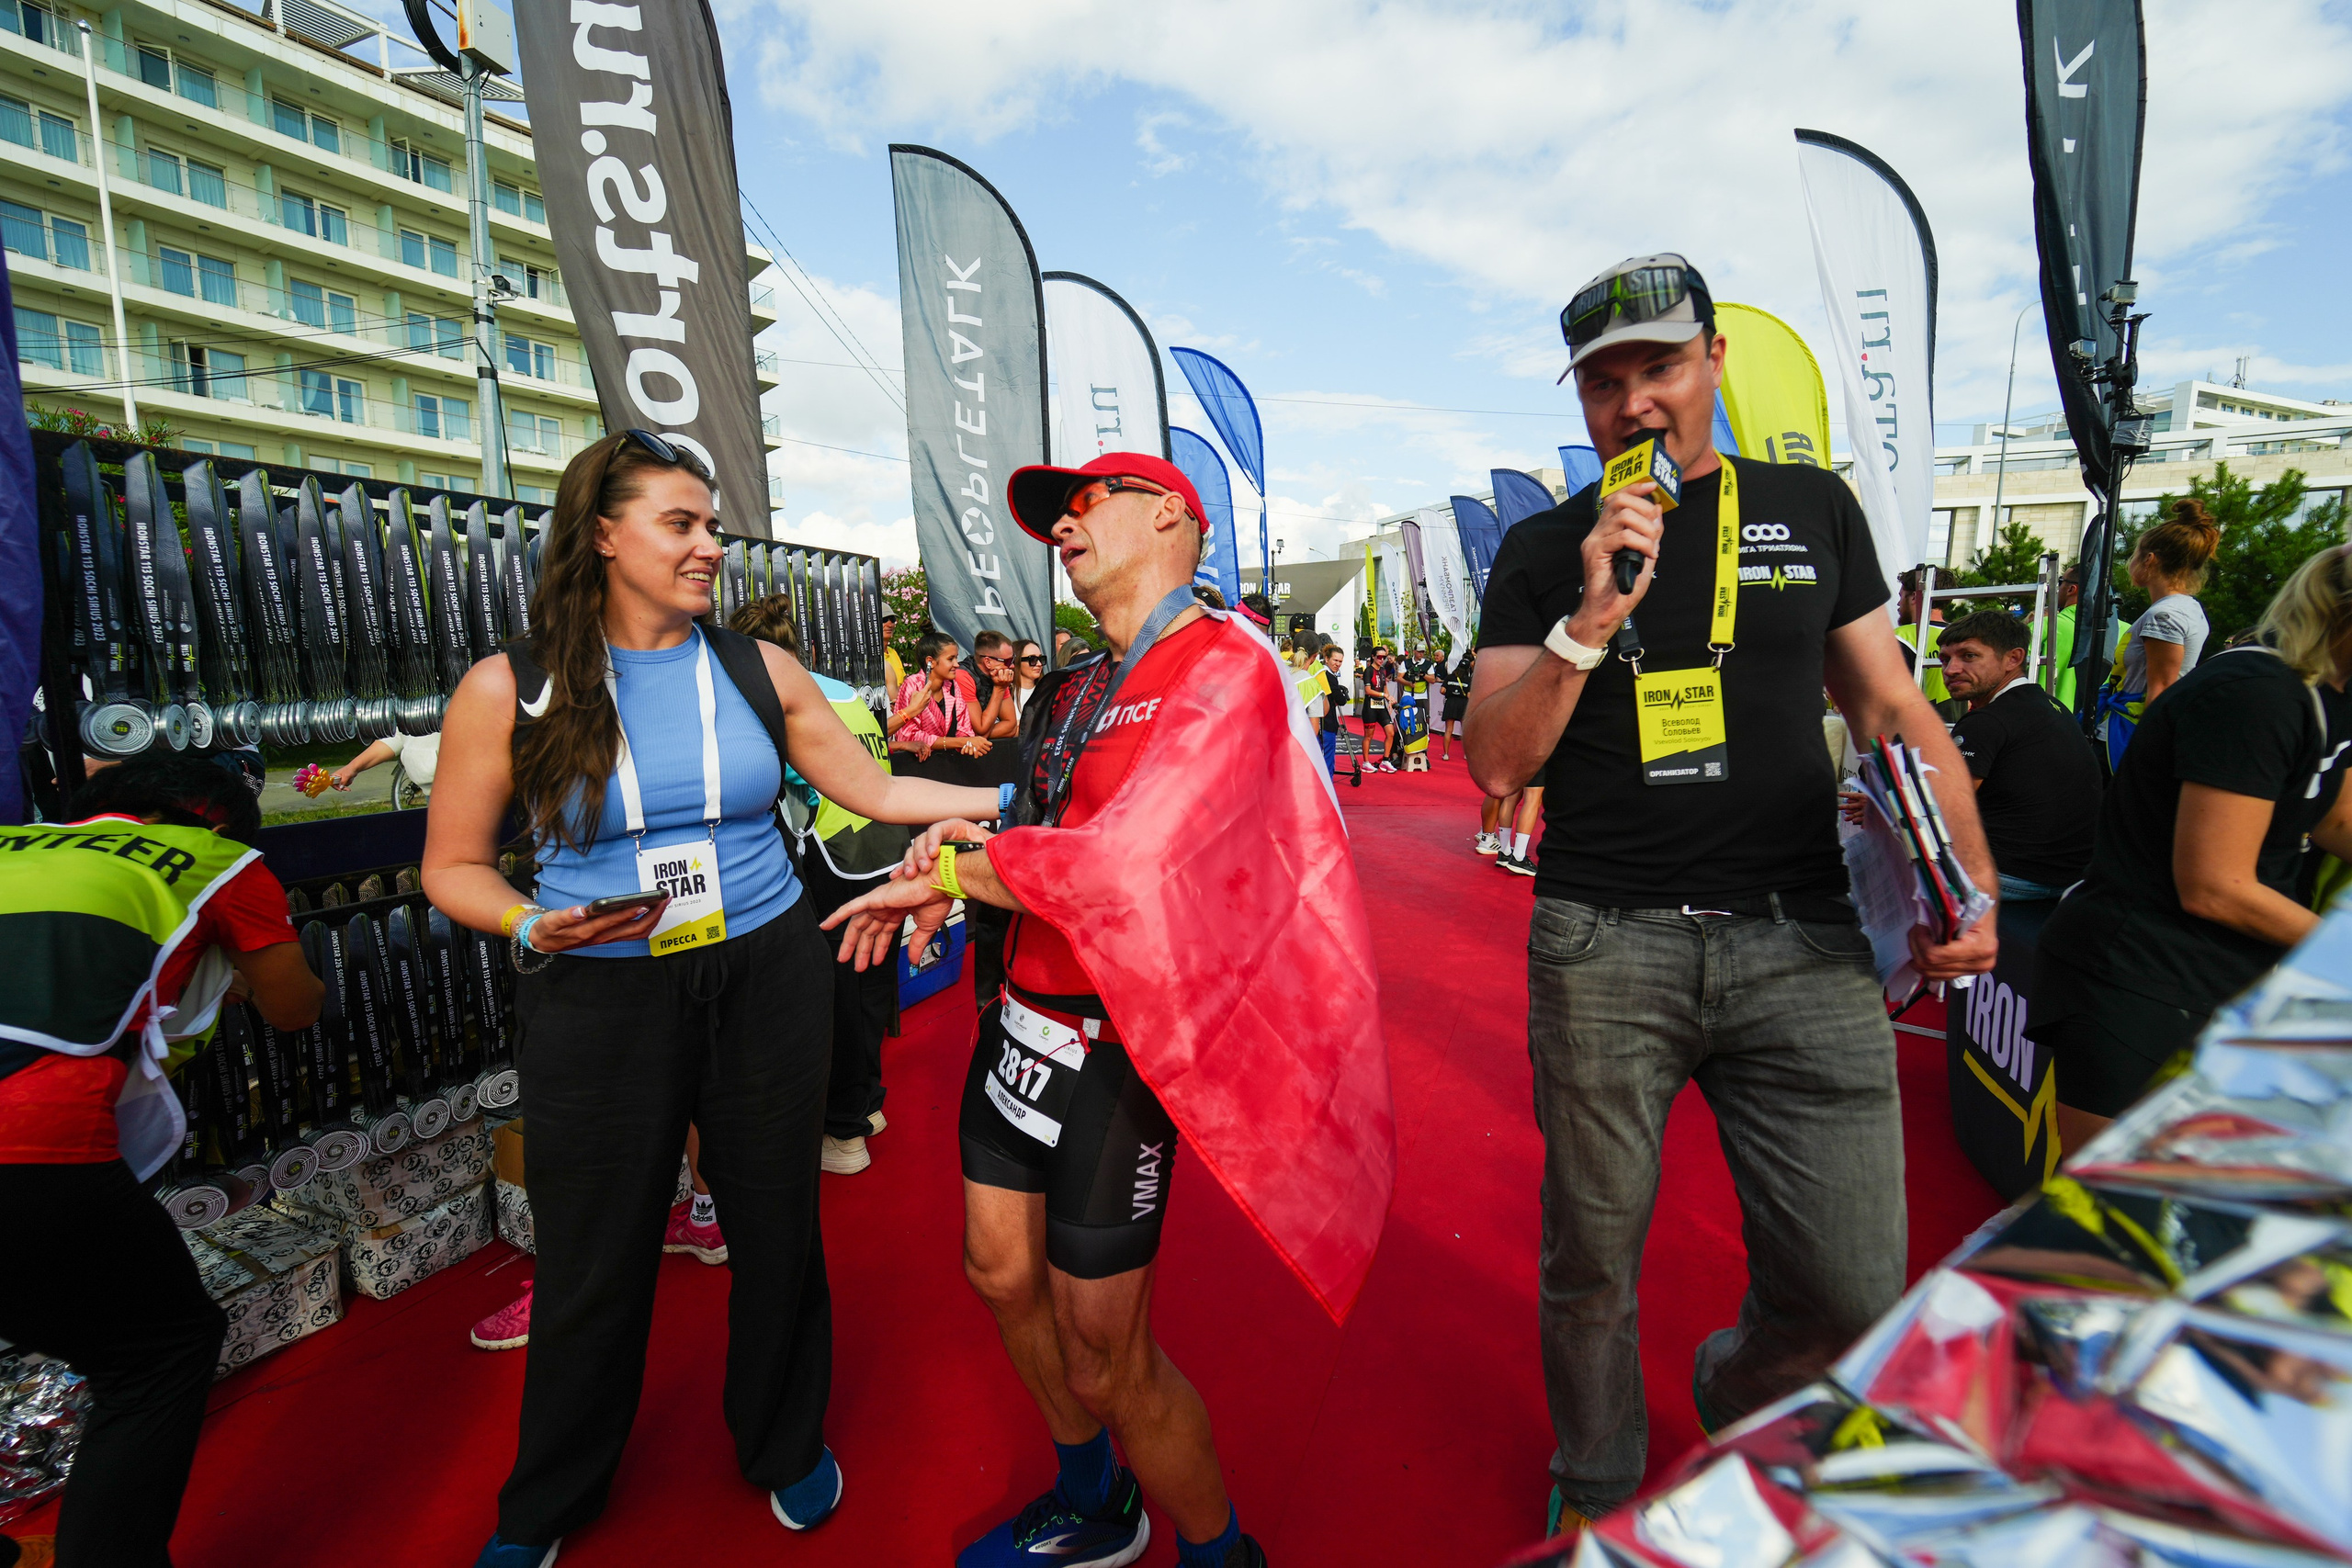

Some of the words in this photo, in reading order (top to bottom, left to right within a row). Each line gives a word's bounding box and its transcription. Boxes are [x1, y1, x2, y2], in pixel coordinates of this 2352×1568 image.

[1574, 283, 1608, 315] IRON
[1611, 456, 1634, 475] IRON
[1656, 451, 1672, 472] IRON
[1609, 461, 1643, 488] STAR
[1654, 462, 1678, 494] STAR
[76, 515, 92, 554] IRONSTAR
[136, 523, 151, 559] IRONSTAR
[203, 527, 221, 563] IRONSTAR
[257, 533, 275, 567] IRONSTAR
[311, 536, 324, 570] IRONSTAR
[1738, 545, 1757, 554] ИГА
[83, 557, 94, 569] 113
[354, 540, 368, 572] IRONSTAR
[401, 545, 414, 575] IRONSTAR
[141, 562, 152, 573] 113
[214, 565, 225, 577] 113
[266, 570, 277, 580] 113
[333, 560, 343, 588] IRONSTAR
[442, 551, 454, 581] IRONSTAR
[478, 553, 488, 582] IRONSTAR
[513, 555, 523, 583] IRONSTAR
[1738, 565, 1772, 581] IRON
[1782, 565, 1816, 580] STAR
[84, 570, 98, 593] SOCHI
[318, 571, 328, 582] 113
[361, 574, 369, 584] 113
[408, 577, 416, 587] 113
[142, 575, 155, 598] SOCHI
[218, 578, 231, 600] SOCHI
[269, 581, 282, 603] SOCHI
[321, 583, 333, 604] SOCHI
[363, 585, 374, 605] SOCHI
[1239, 582, 1257, 594] RON
[1719, 586, 1727, 600] STAR
[410, 588, 421, 607] SOCHI
[450, 592, 460, 611] SOCHI
[482, 594, 491, 612] SOCHI
[518, 594, 527, 612] SOCHI
[87, 596, 102, 620] SIRIUS
[146, 600, 161, 624] SIRIUS
[224, 602, 236, 624] SIRIUS
[276, 604, 287, 625] SIRIUS
[325, 605, 336, 626] SIRIUS
[368, 606, 379, 626] SIRIUS
[414, 608, 425, 627] SIRIUS
[454, 612, 464, 631] SIRIUS
[485, 613, 493, 631] SIRIUS
[521, 613, 530, 631] SIRIUS
[92, 623, 107, 641] 2023
[152, 626, 164, 643] 2023
[230, 626, 239, 643] 2023
[282, 627, 290, 643] 2023
[331, 628, 340, 643] 2023
[373, 627, 381, 643] 2023
[420, 629, 428, 644] 2023
[488, 633, 496, 647] 2023
[181, 645, 190, 656] STAR
[184, 661, 192, 671] IRON
[1644, 689, 1671, 703] IRON
[1685, 685, 1714, 699] STAR
[1063, 709, 1077, 735] SIRIUS
[1662, 717, 1701, 728] Всеволод
[1663, 727, 1702, 737] Соловьев
[1683, 736, 1712, 745] Solovyov
[855, 733, 890, 761] NTE
[1054, 735, 1065, 757] 2023
[1057, 777, 1067, 793] IRON
[1065, 757, 1075, 773] STAR
[1649, 768, 1699, 778] ОРГАНИЗАТОР
[0, 833, 196, 886] NTEER
[652, 859, 688, 880] IRON
[655, 874, 707, 899] STAR
[372, 919, 385, 946] IRONSTAR
[660, 932, 697, 950] ПРЕССА
[330, 930, 341, 957] IRONSTAR
[379, 946, 388, 956] 226
[334, 958, 343, 968] 226
[381, 956, 390, 973] SOCHI
[479, 941, 489, 969] IRONSTAR
[335, 969, 345, 986] SOCHI
[400, 960, 412, 990] IRONSTAR
[482, 969, 491, 979] 113
[358, 970, 371, 1001] IRONSTAR
[440, 948, 449, 977] IRONSTAR
[447, 1006, 456, 1024] SIRIUS
[484, 979, 493, 997] SOCHI
[365, 1001, 373, 1012] 113
[407, 1000, 418, 1020] SOCHI
[487, 997, 495, 1015] SIRIUS
[312, 1021, 322, 1042] SOCHI
[366, 1012, 377, 1032] SOCHI
[411, 1020, 421, 1038] SIRIUS
[1965, 970, 2035, 1093] IRON
[266, 1038, 277, 1057] SOCHI
[369, 1032, 380, 1052] SIRIUS
[314, 1042, 324, 1063] SIRIUS
[374, 1052, 383, 1066] 2023
[998, 1039, 1053, 1102] 2817
[997, 1089, 1027, 1121] АЛЕКСАНДР
[1131, 1141, 1163, 1222] VMAX
[691, 1213, 713, 1222] adidas
[1035, 1540, 1052, 1550] BROOKS
